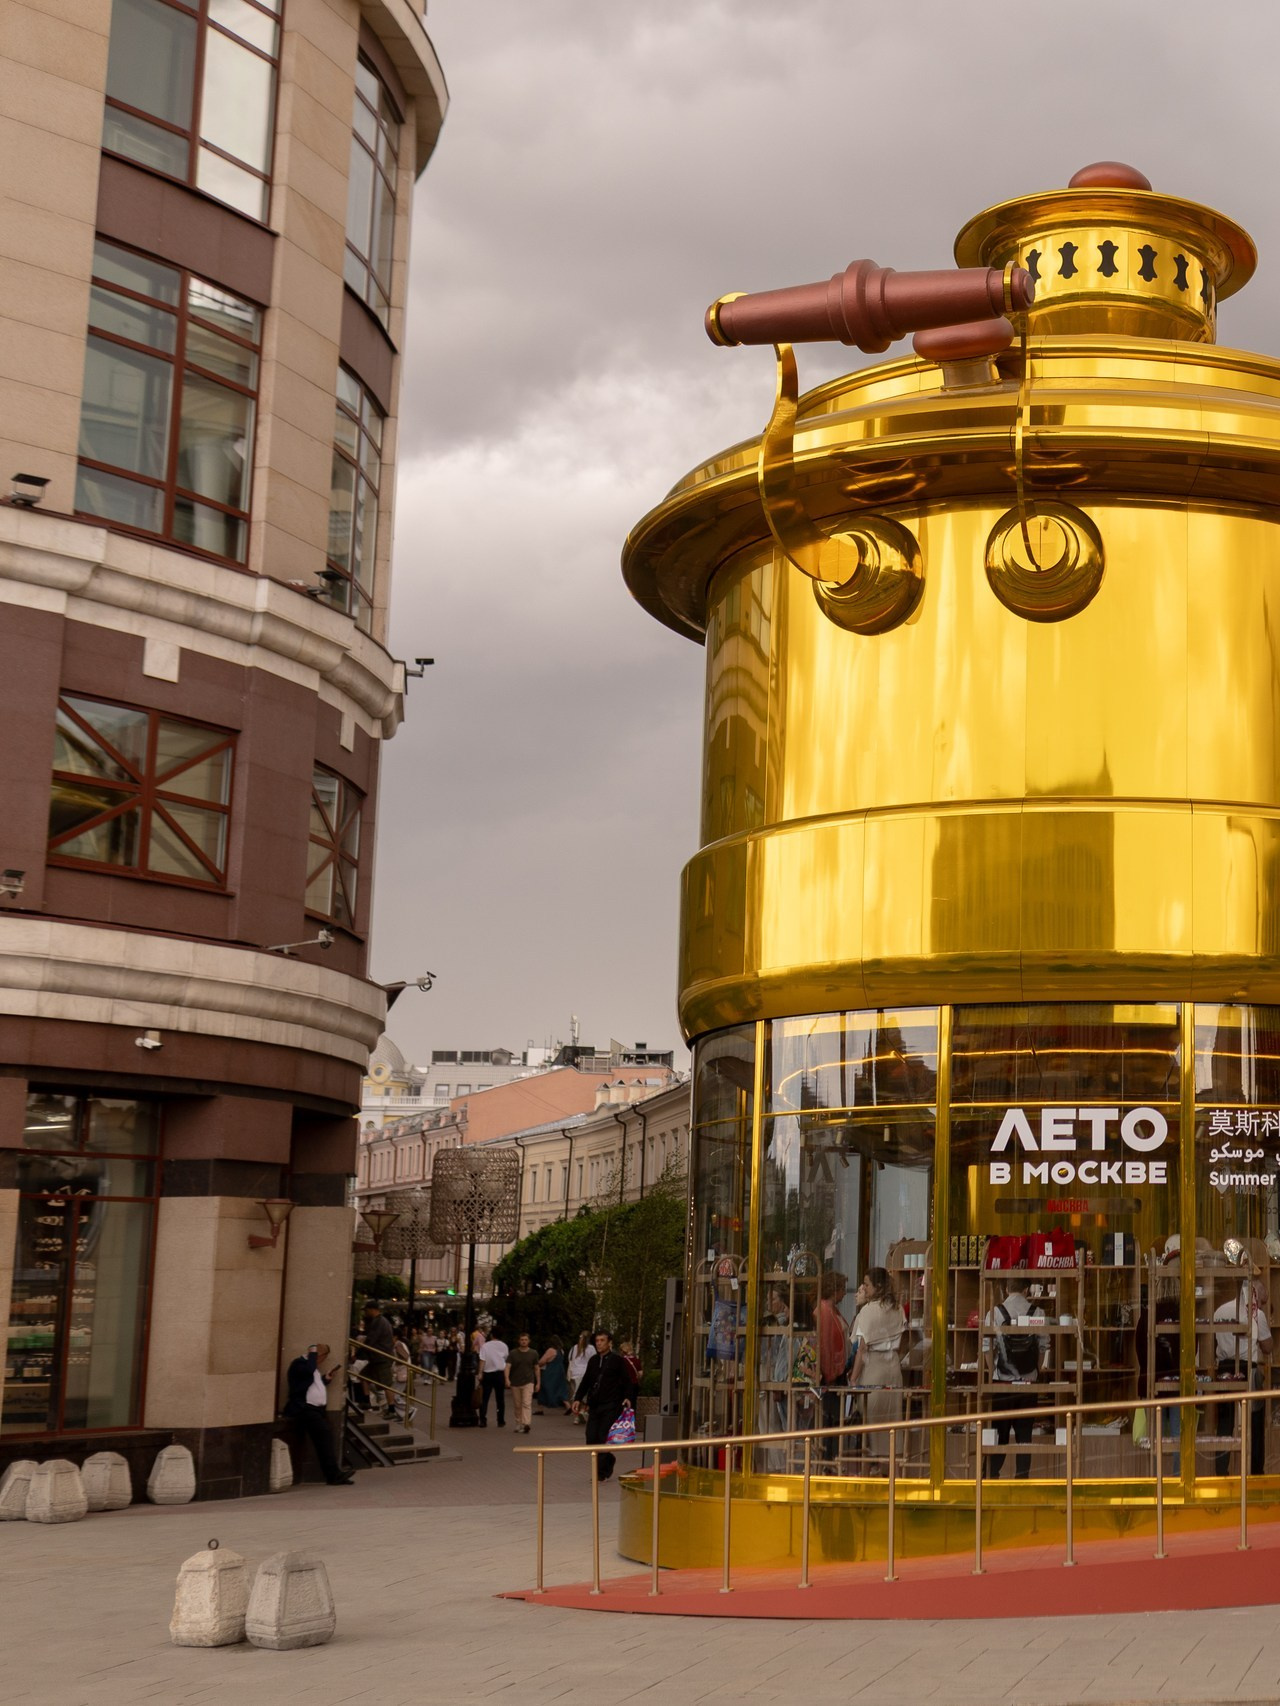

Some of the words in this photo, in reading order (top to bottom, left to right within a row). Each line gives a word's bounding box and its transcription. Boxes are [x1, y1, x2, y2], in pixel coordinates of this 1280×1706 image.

[990, 1107, 1168, 1152] ЛЕТО
[1209, 1142, 1265, 1163] موسكو
[989, 1162, 1012, 1185] В
[1023, 1161, 1168, 1185] МОСКВЕ
[1209, 1171, 1277, 1186] Summer
